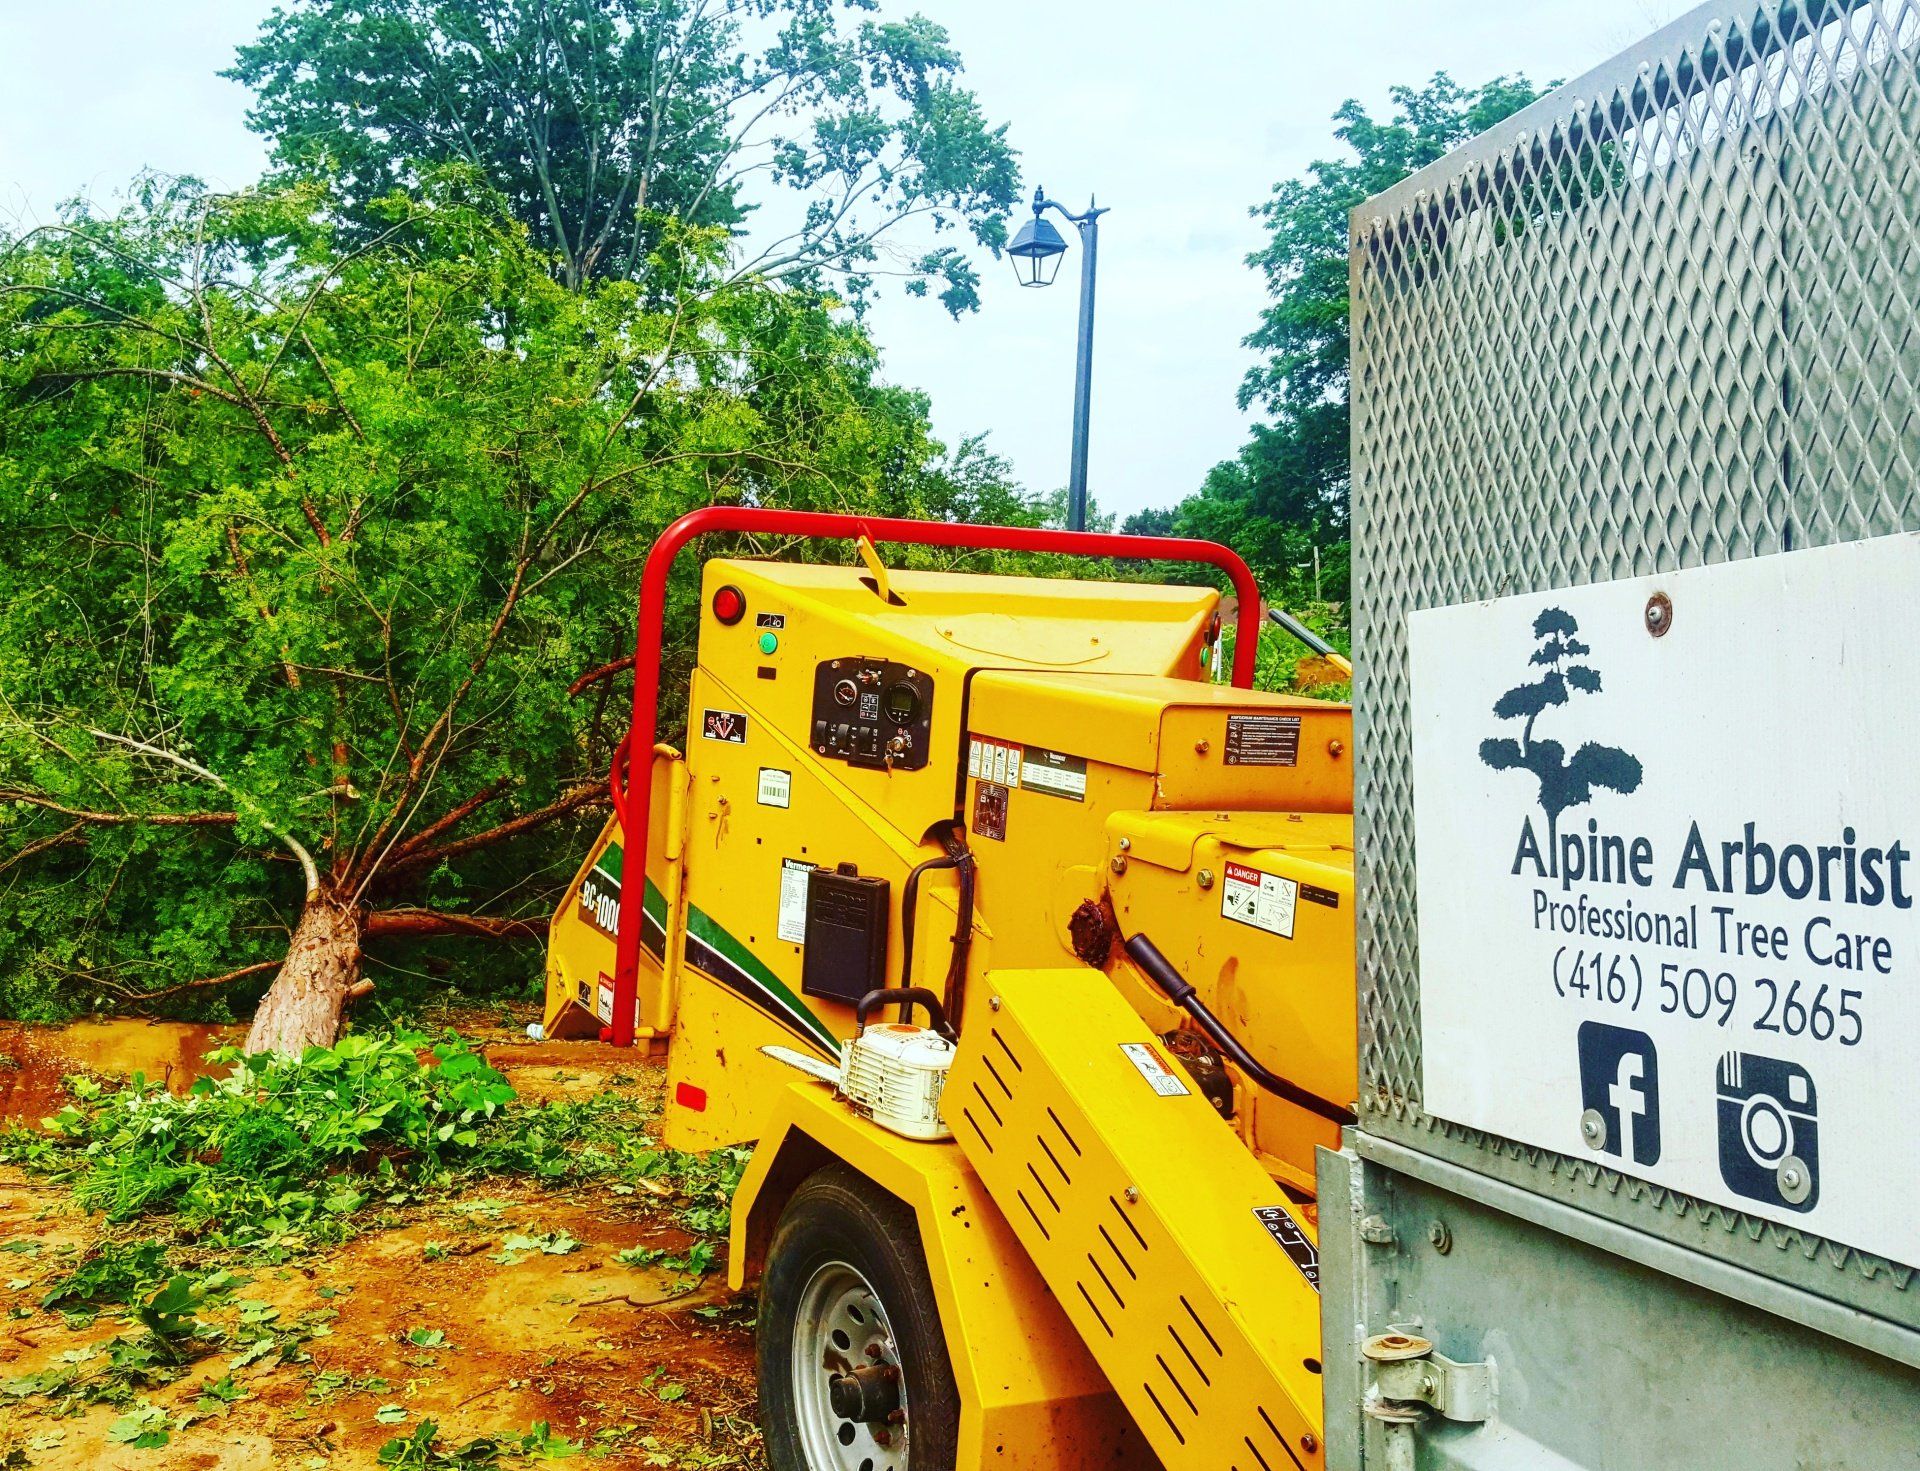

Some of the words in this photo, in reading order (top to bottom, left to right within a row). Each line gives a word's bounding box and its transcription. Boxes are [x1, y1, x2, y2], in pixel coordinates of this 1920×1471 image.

[1234, 867, 1258, 882] DANGER
[1510, 813, 1654, 892] Alpine
[1672, 819, 1913, 909] Arborist
[1533, 888, 1698, 950] Professional
[1711, 906, 1789, 959] Tree
[1804, 915, 1893, 974] Care
[1553, 945, 1643, 1012] (416)
[1660, 962, 1737, 1028] 509
[1753, 978, 1863, 1046] 2665
